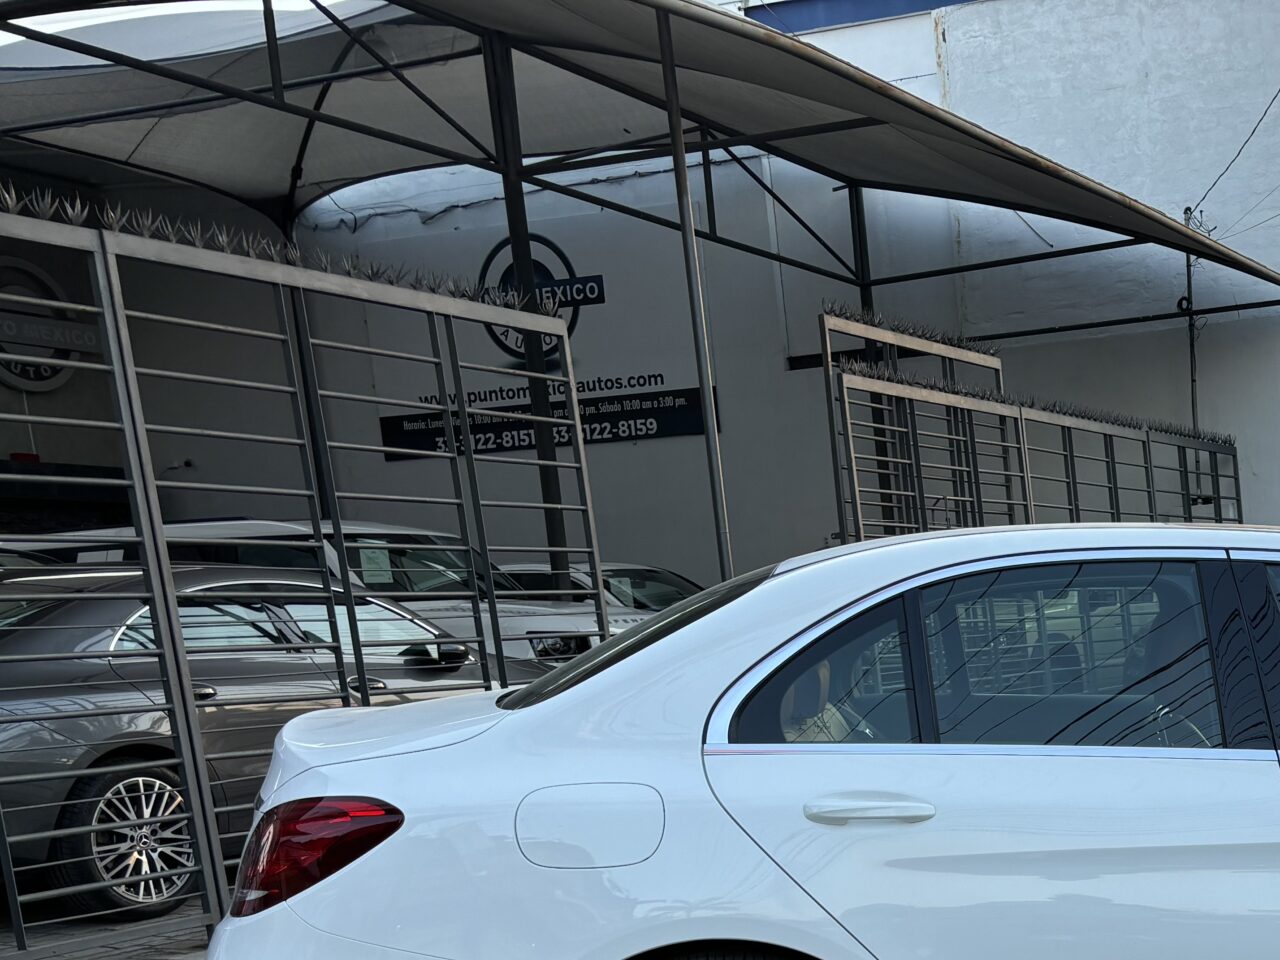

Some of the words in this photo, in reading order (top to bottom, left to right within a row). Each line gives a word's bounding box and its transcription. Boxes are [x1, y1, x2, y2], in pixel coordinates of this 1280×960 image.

[535, 281, 599, 304] EXICO
[623, 399, 641, 410] 10:00
[659, 396, 674, 408] 3:00
